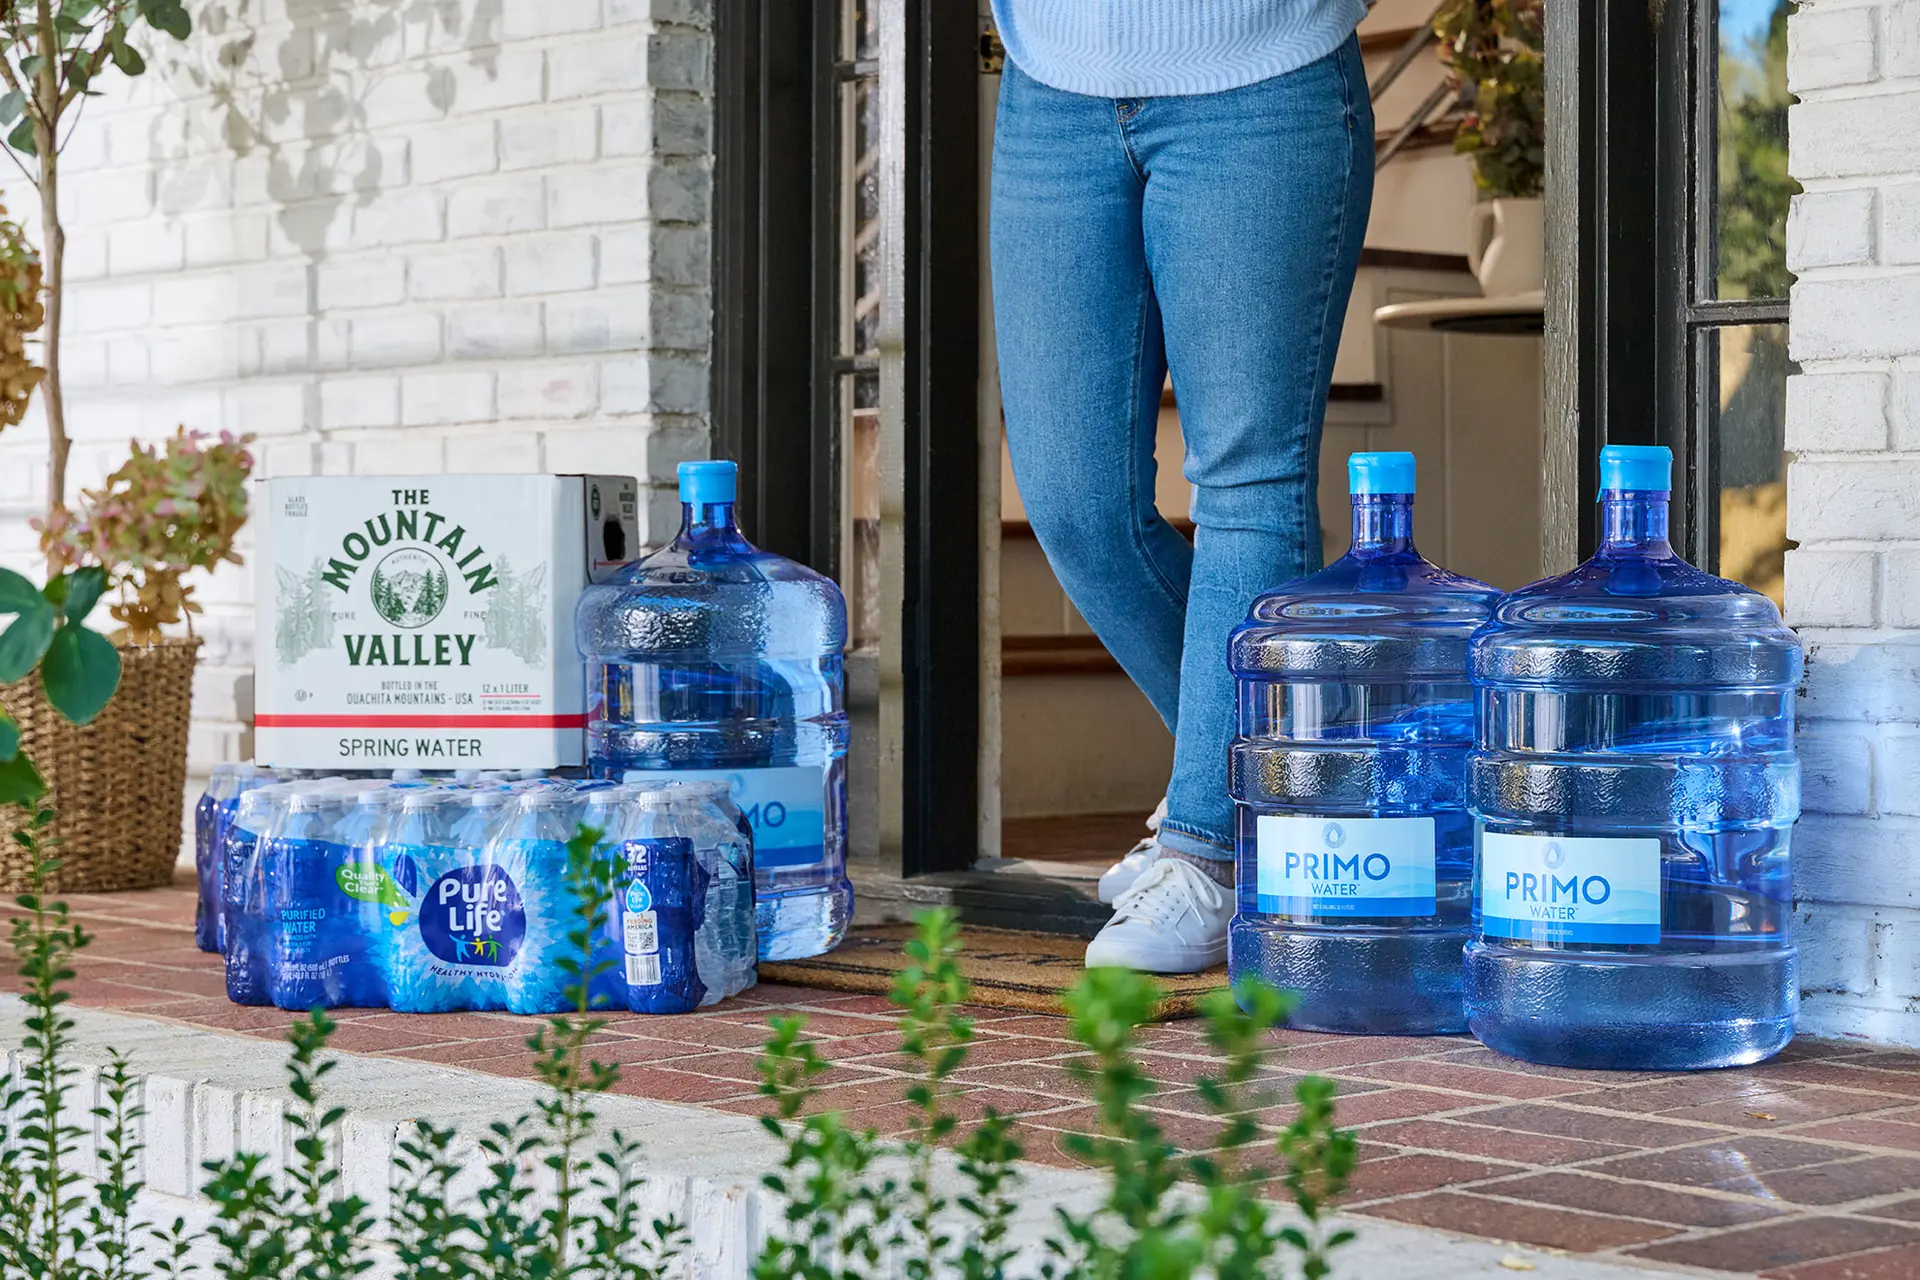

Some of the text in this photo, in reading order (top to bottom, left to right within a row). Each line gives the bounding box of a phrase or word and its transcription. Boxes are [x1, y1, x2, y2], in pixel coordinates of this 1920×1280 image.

[391, 489, 430, 505] THE
[321, 509, 499, 595] MOUNTAIN
[391, 552, 429, 566] AUTHENTIC
[331, 610, 356, 620] PURE
[343, 634, 477, 666] VALLEY
[381, 680, 438, 691] BOTTLED IN THE
[482, 683, 491, 694] 12
[505, 683, 530, 694] LITER
[346, 692, 392, 705] OUACHITA
[394, 692, 446, 705] MOUNTAINS
[455, 692, 474, 705] USA
[339, 738, 483, 757] SPRING WATER
[625, 842, 647, 864] 32
[1285, 851, 1391, 881] PRIMO
[341, 869, 386, 883] Quality
[344, 881, 379, 894] Clear
[439, 878, 508, 906] Pure
[1311, 883, 1358, 896] WATER
[1506, 871, 1611, 905] PRIMO
[281, 908, 326, 921] PURIFIED
[1529, 904, 1577, 920] WATER
[449, 902, 503, 937] Life
[283, 920, 316, 934] WATER
[430, 964, 474, 977] HEALTHY
